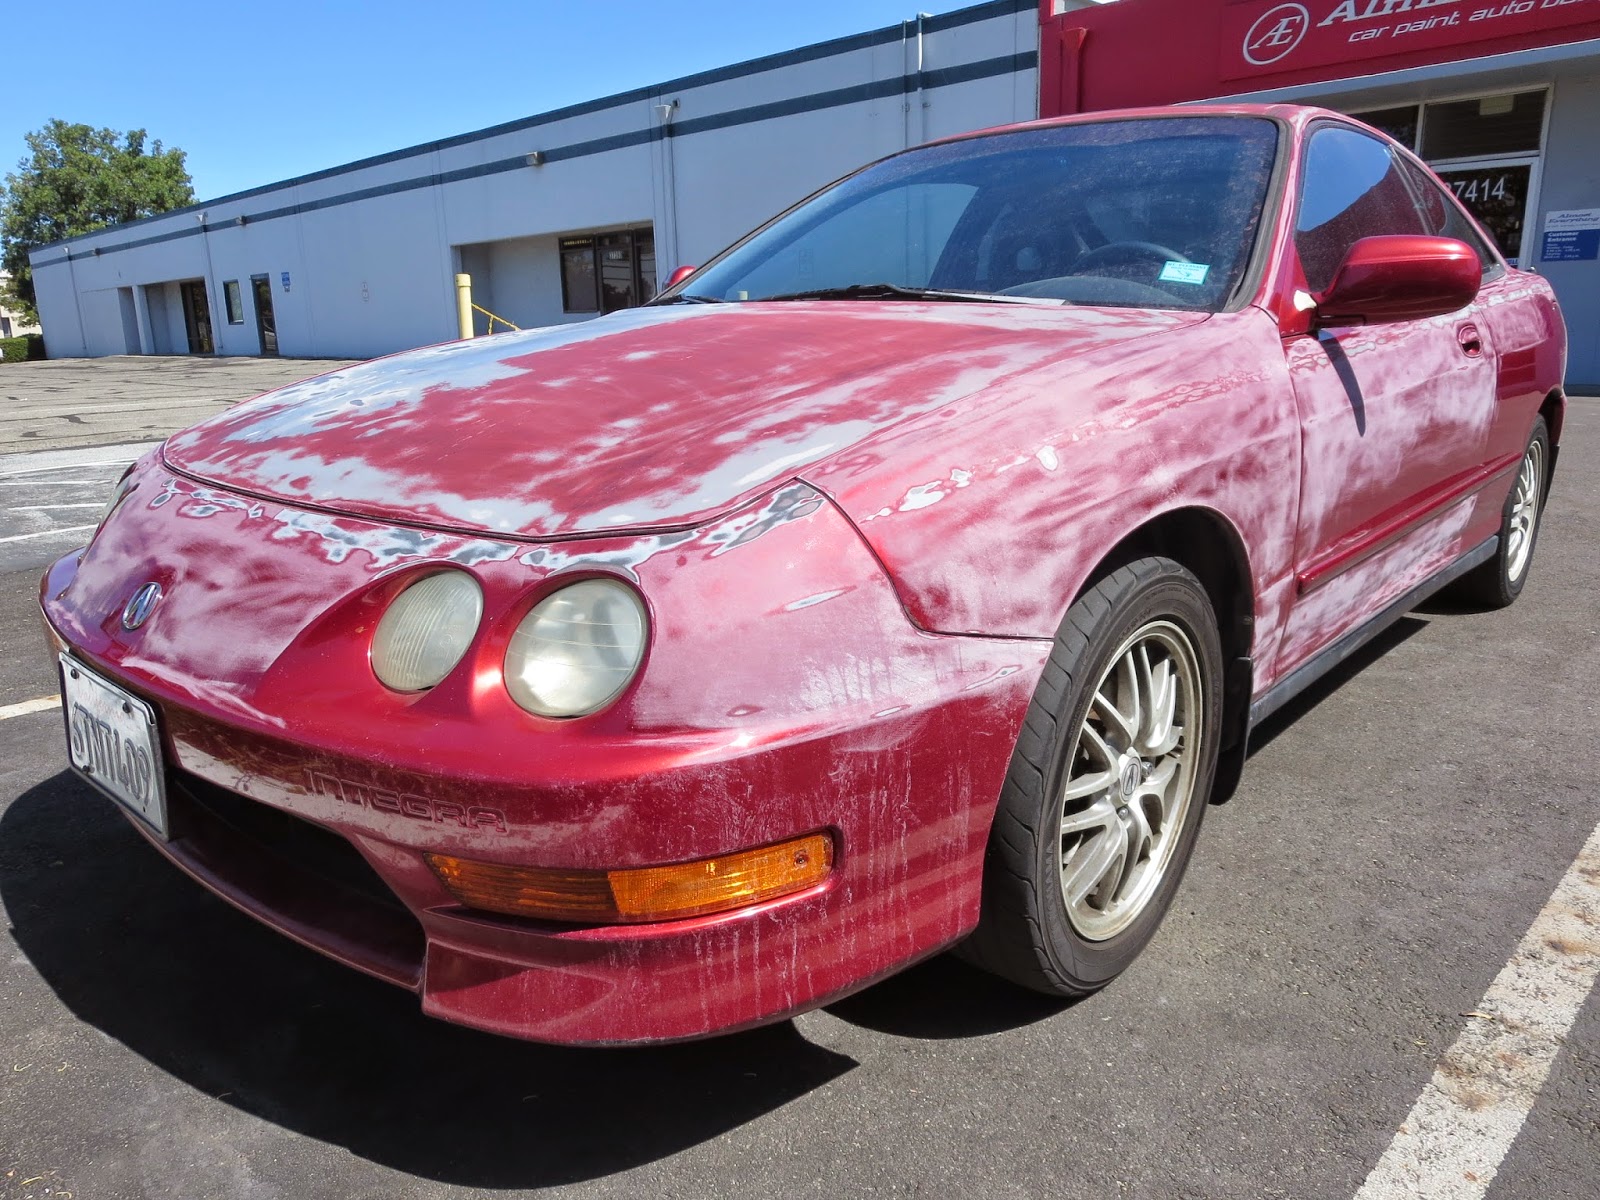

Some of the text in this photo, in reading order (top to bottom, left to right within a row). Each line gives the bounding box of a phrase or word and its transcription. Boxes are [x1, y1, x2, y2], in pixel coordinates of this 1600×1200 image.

[1348, 26, 1390, 42] car
[1391, 11, 1460, 38] paint,
[1468, 0, 1535, 21] auto
[303, 768, 508, 834] INTEGRA
